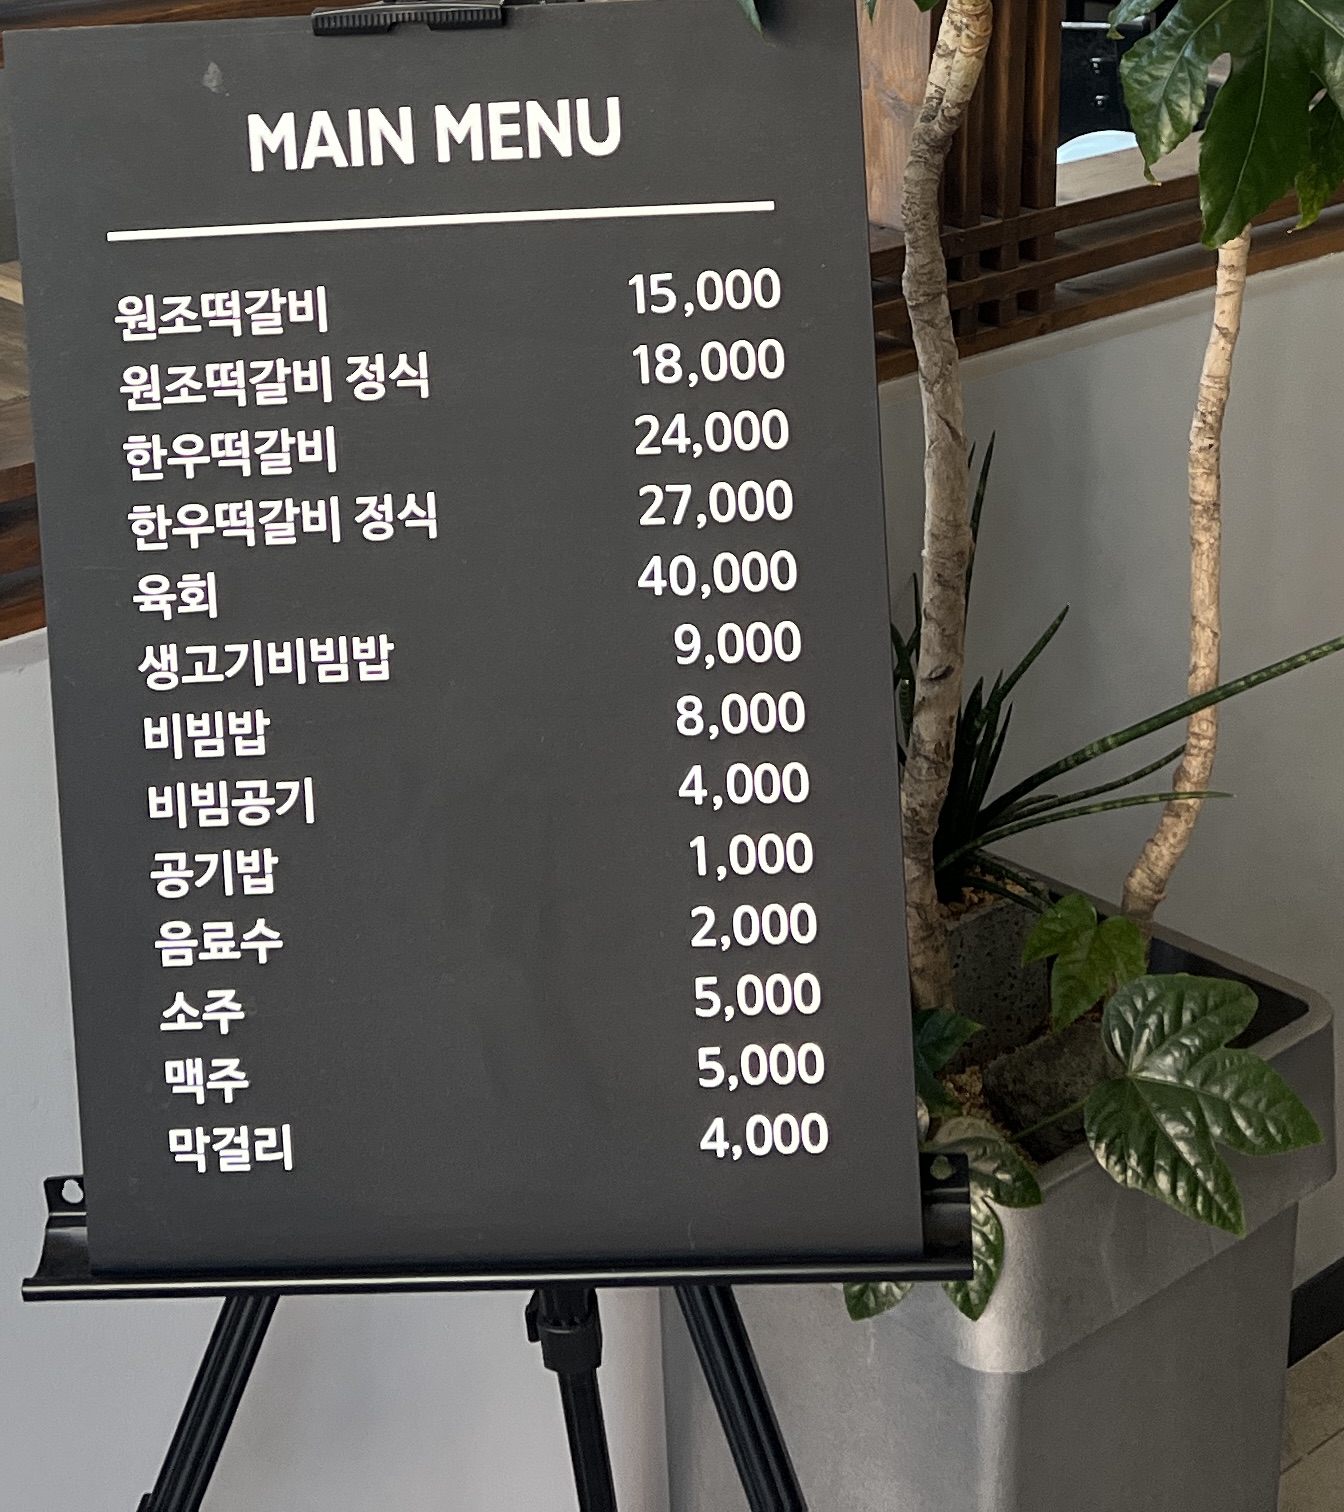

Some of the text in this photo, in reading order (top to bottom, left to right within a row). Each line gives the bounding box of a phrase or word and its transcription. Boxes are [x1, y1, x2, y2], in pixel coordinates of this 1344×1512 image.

[247, 96, 621, 172] MAIN MENU
[114, 267, 781, 342] 원조떡갈비 15,000
[119, 338, 785, 412] 원조떡갈비 정식 18,000
[122, 408, 789, 482] 한우떡갈비 24,000
[127, 479, 794, 552] 한우떡갈비 정식 27,000
[132, 549, 798, 621] 육회 40,000
[137, 620, 802, 691] 생고기비빔밥 9,000
[143, 690, 806, 760] 비빔밥 8,000
[147, 761, 810, 829] 비빔공기 4,000
[150, 832, 814, 899] 공기밥 1,000
[154, 902, 818, 968] 음료수 2,000
[159, 972, 821, 1035] 소주 5,000
[164, 1042, 825, 1105] 맥주 5,000
[168, 1112, 829, 1174] 막걸리 4,000
